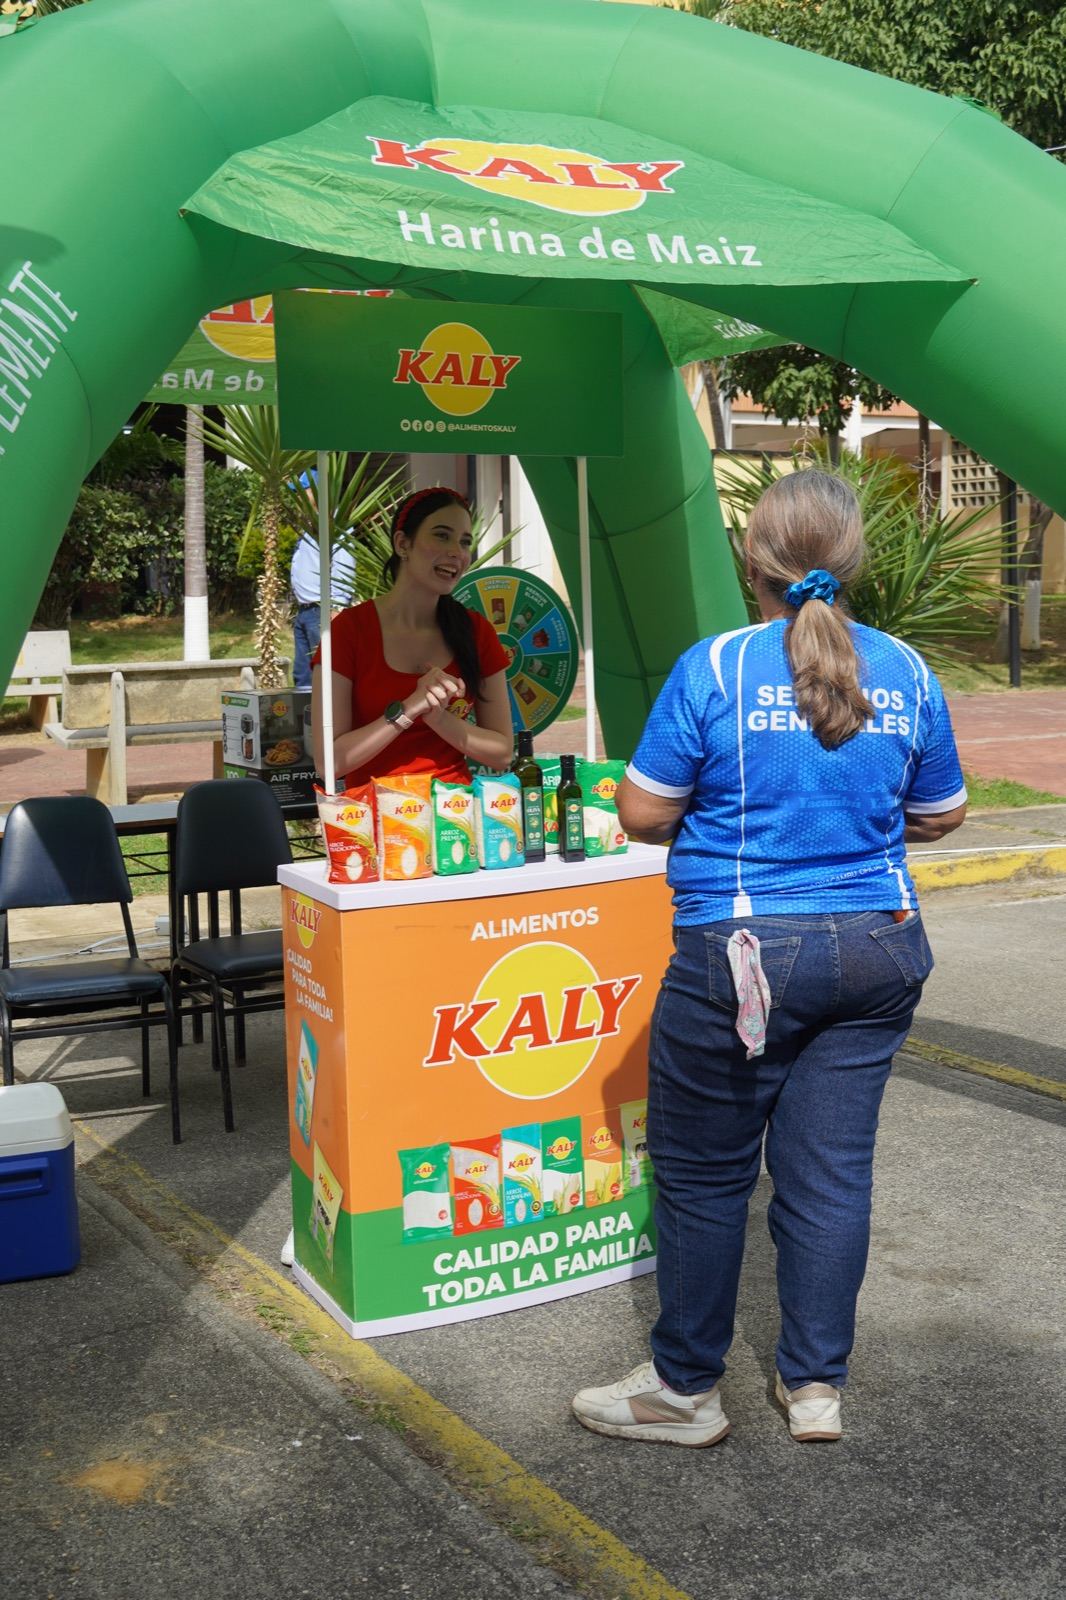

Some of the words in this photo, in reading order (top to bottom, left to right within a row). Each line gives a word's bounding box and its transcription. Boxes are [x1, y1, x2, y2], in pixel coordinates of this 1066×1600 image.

[367, 136, 684, 193] KALY
[397, 210, 565, 258] Harina
[578, 227, 636, 260] de
[646, 233, 762, 266] Maiz
[393, 348, 521, 389] KALY
[447, 423, 517, 433] @ALIMENTOSKALY
[747, 710, 910, 736] GENLES
[270, 774, 291, 782] AIR
[292, 771, 320, 779] FRYE
[592, 784, 618, 793] KAL
[394, 804, 425, 816] KALY
[443, 799, 471, 809] KALY
[490, 797, 518, 809] KALY
[336, 810, 367, 822] KALY
[290, 898, 322, 934] KALY
[471, 906, 599, 941] ALIMENTOS
[423, 974, 642, 1067] KALY
[589, 1131, 615, 1145] KALY
[546, 1141, 577, 1156] KALY
[414, 1164, 437, 1175] KALY
[464, 1164, 489, 1175] KALY
[508, 1157, 536, 1169] KALY
[433, 1231, 559, 1275] CALIDAD
[566, 1211, 634, 1247] PARA
[423, 1272, 506, 1307] TODA
[512, 1263, 548, 1289] LA
[554, 1233, 653, 1279] FAMILIA
